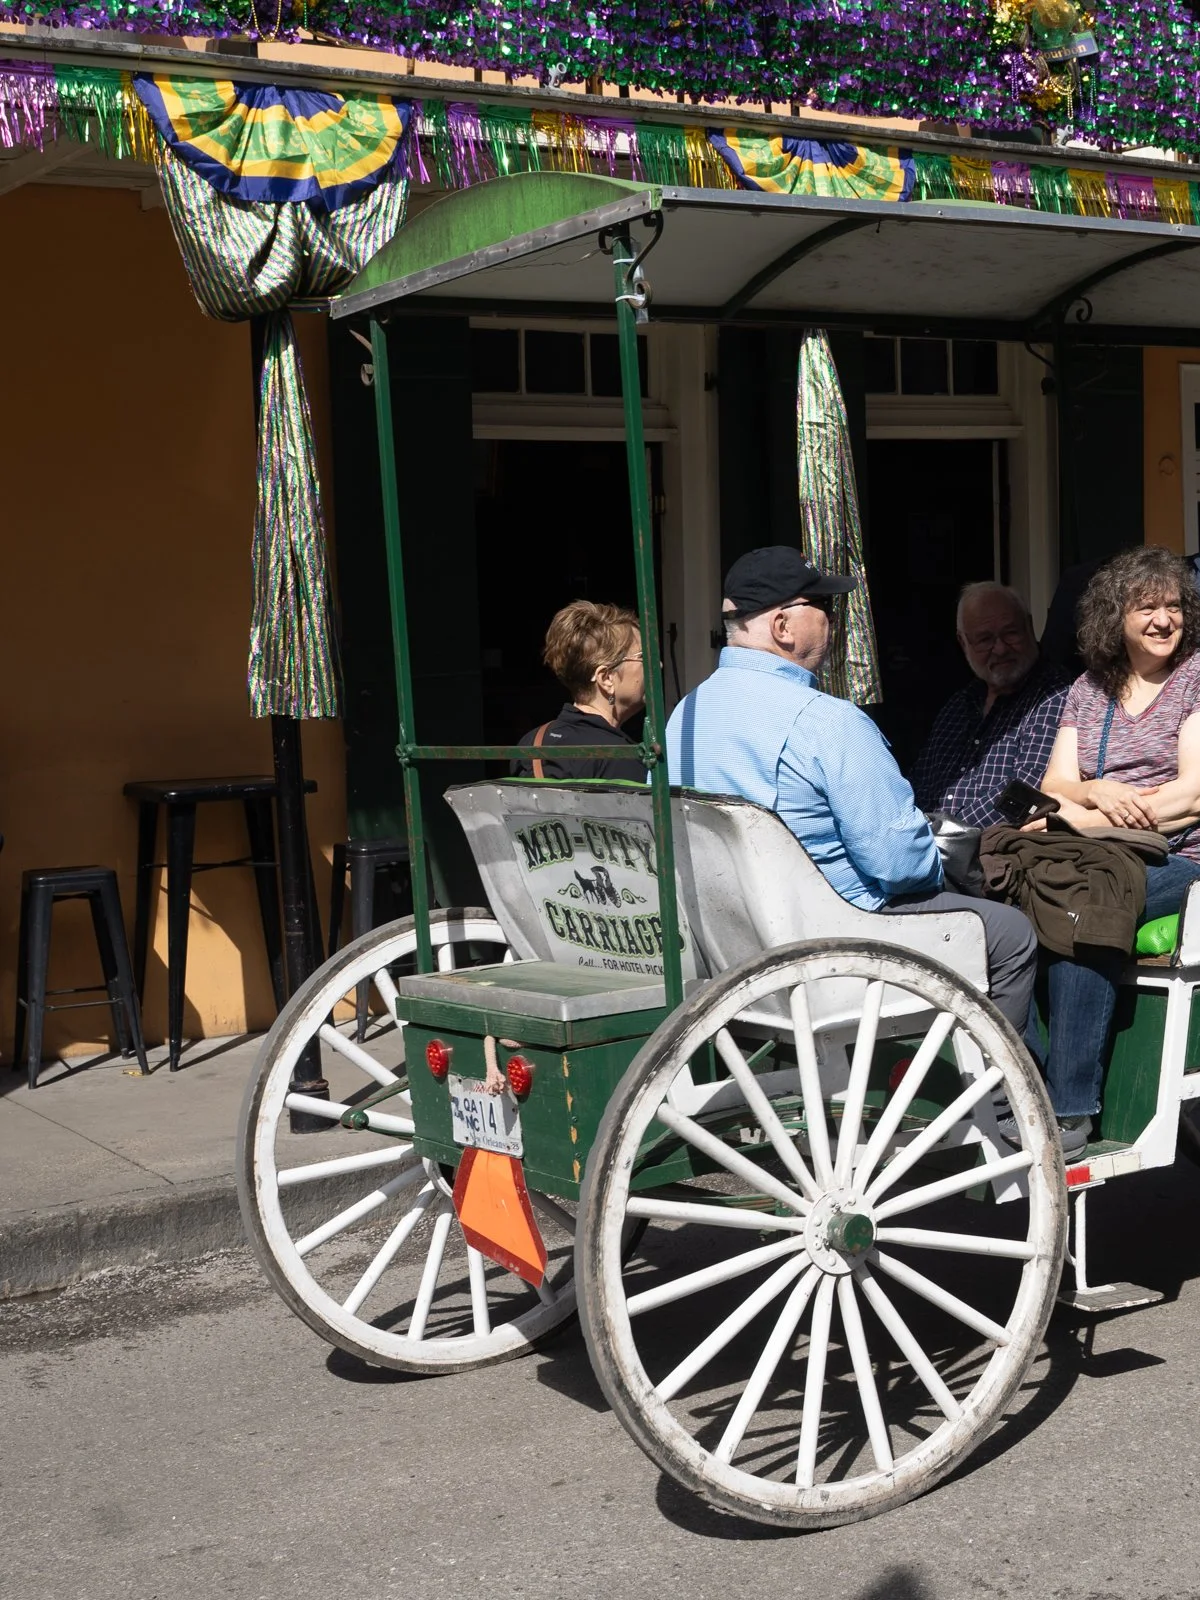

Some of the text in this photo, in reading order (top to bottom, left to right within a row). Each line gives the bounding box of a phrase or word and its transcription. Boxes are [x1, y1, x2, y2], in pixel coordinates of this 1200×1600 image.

[1041, 45, 1086, 59] ourbon
[517, 821, 659, 876] MID-CITY
[545, 900, 685, 956] CARRIAGE
[602, 958, 620, 971] FOR
[619, 960, 646, 974] HOTEL
[463, 1098, 478, 1114] QA
[465, 1114, 480, 1132] NC
[479, 1100, 497, 1134] 14
